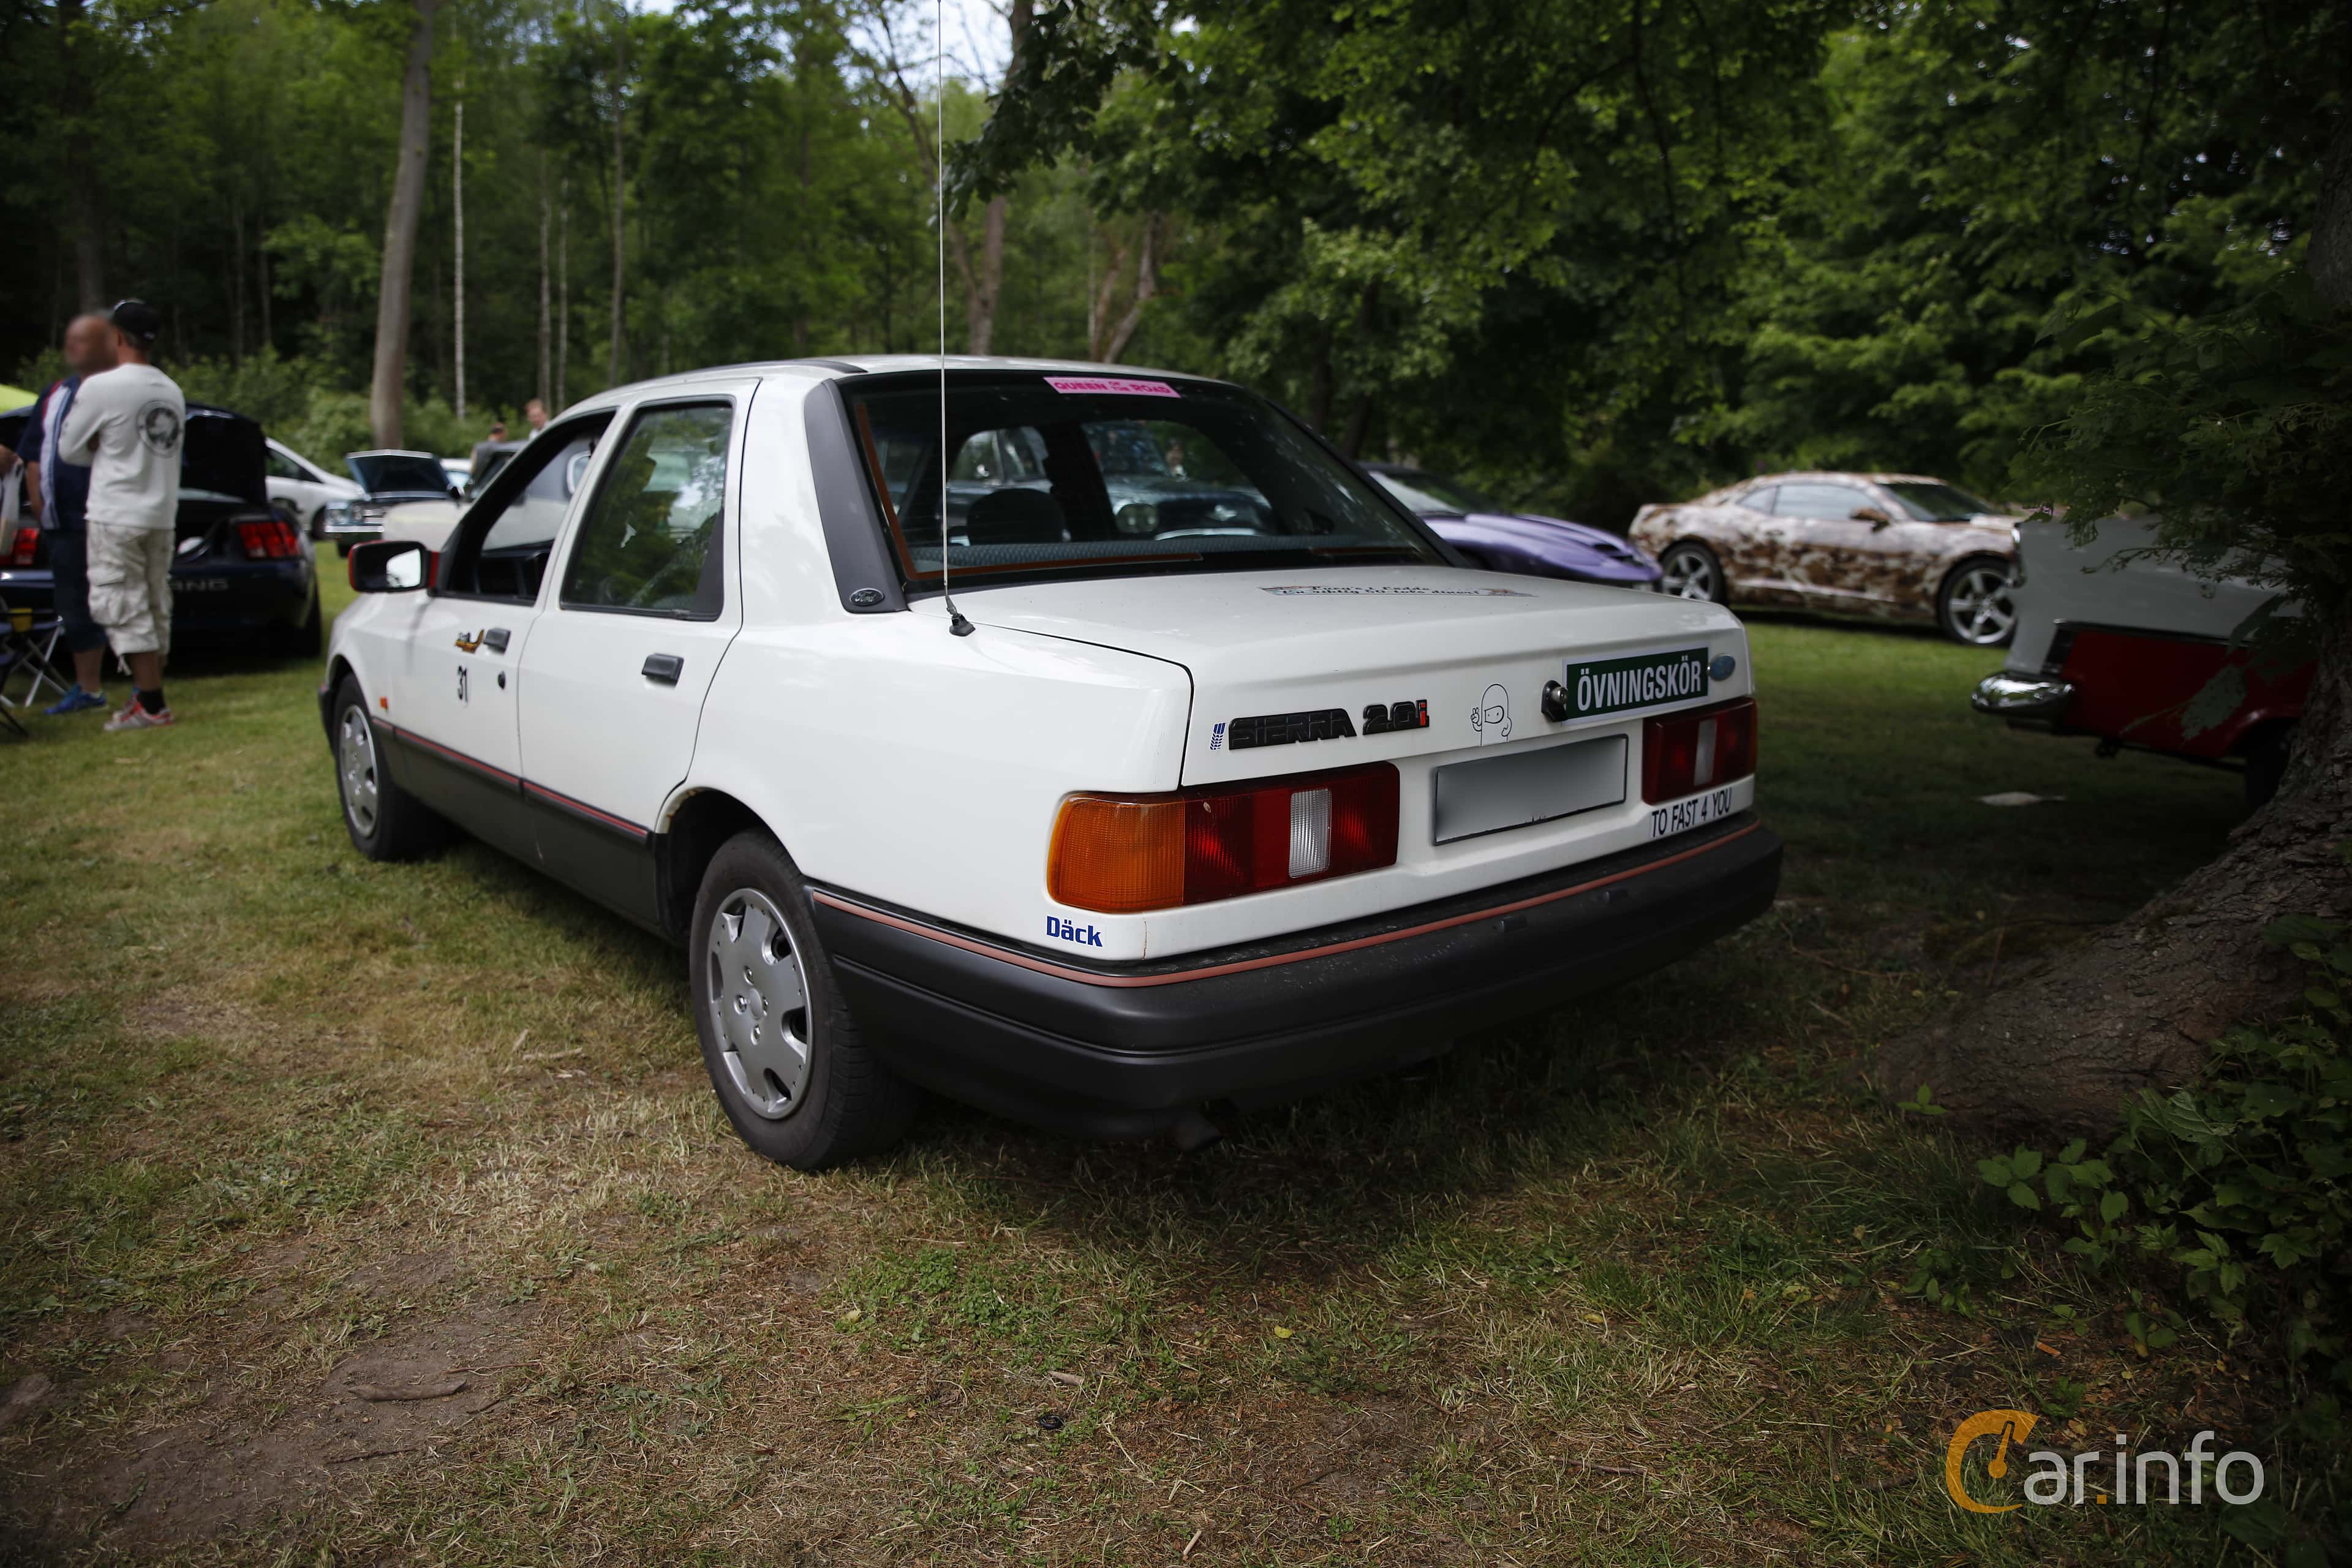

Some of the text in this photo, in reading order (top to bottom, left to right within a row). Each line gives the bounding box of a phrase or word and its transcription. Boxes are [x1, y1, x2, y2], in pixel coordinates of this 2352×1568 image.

[1129, 384, 1171, 393] ROAD
[854, 592, 876, 603] Ford
[457, 665, 468, 703] 31
[1576, 654, 1703, 712] ÖVNINGSKÖR
[1651, 787, 1732, 838] TO FAST 4 YOU
[1046, 916, 1102, 947] Däck
